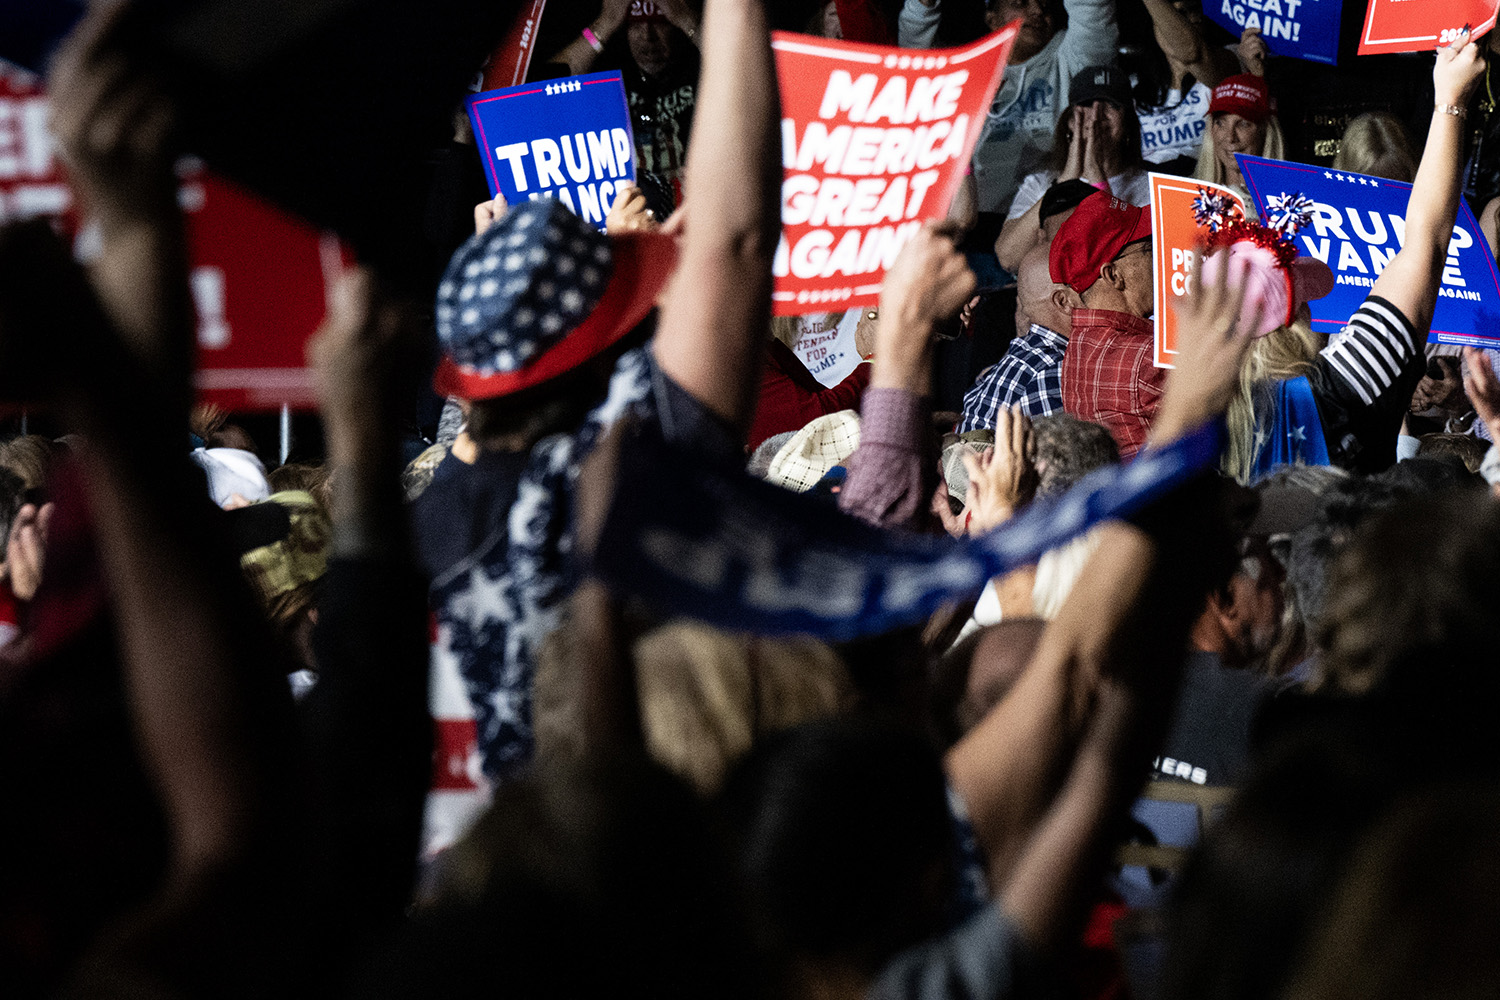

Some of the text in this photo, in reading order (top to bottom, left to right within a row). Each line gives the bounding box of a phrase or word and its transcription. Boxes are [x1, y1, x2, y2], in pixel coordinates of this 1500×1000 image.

[519, 19, 534, 49] 2024
[1439, 28, 1464, 43] 202
[819, 69, 970, 124] MAKE
[495, 127, 633, 192] TRUMP
[1142, 119, 1206, 149] RUMP
[781, 170, 939, 226] GREAT
[1266, 194, 1473, 257] RUP
[1302, 236, 1466, 287] VANE
[1336, 274, 1481, 302] AMERI AGAIN!
